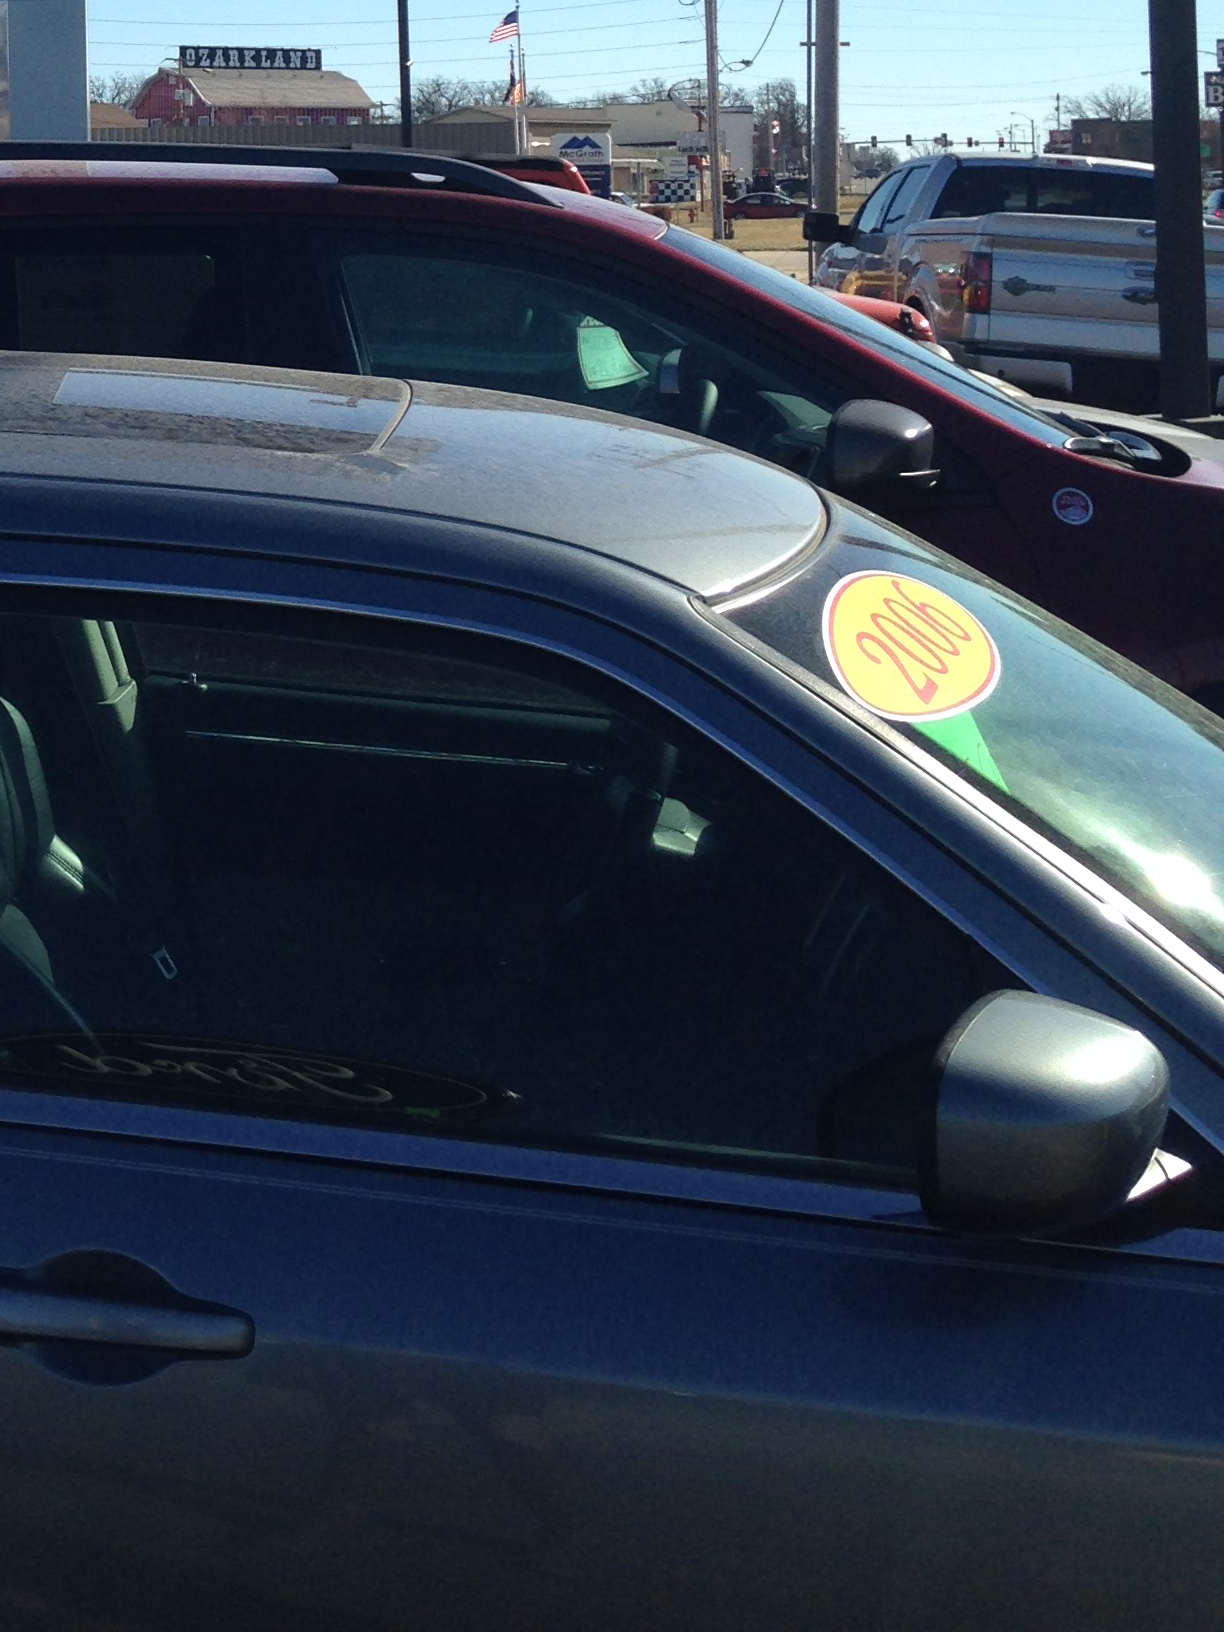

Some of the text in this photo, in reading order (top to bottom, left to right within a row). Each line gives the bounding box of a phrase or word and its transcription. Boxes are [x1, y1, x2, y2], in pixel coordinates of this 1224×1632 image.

[185, 48, 317, 68] OZARKLAND
[558, 149, 605, 158] McGrath
[855, 579, 972, 705] 2006
